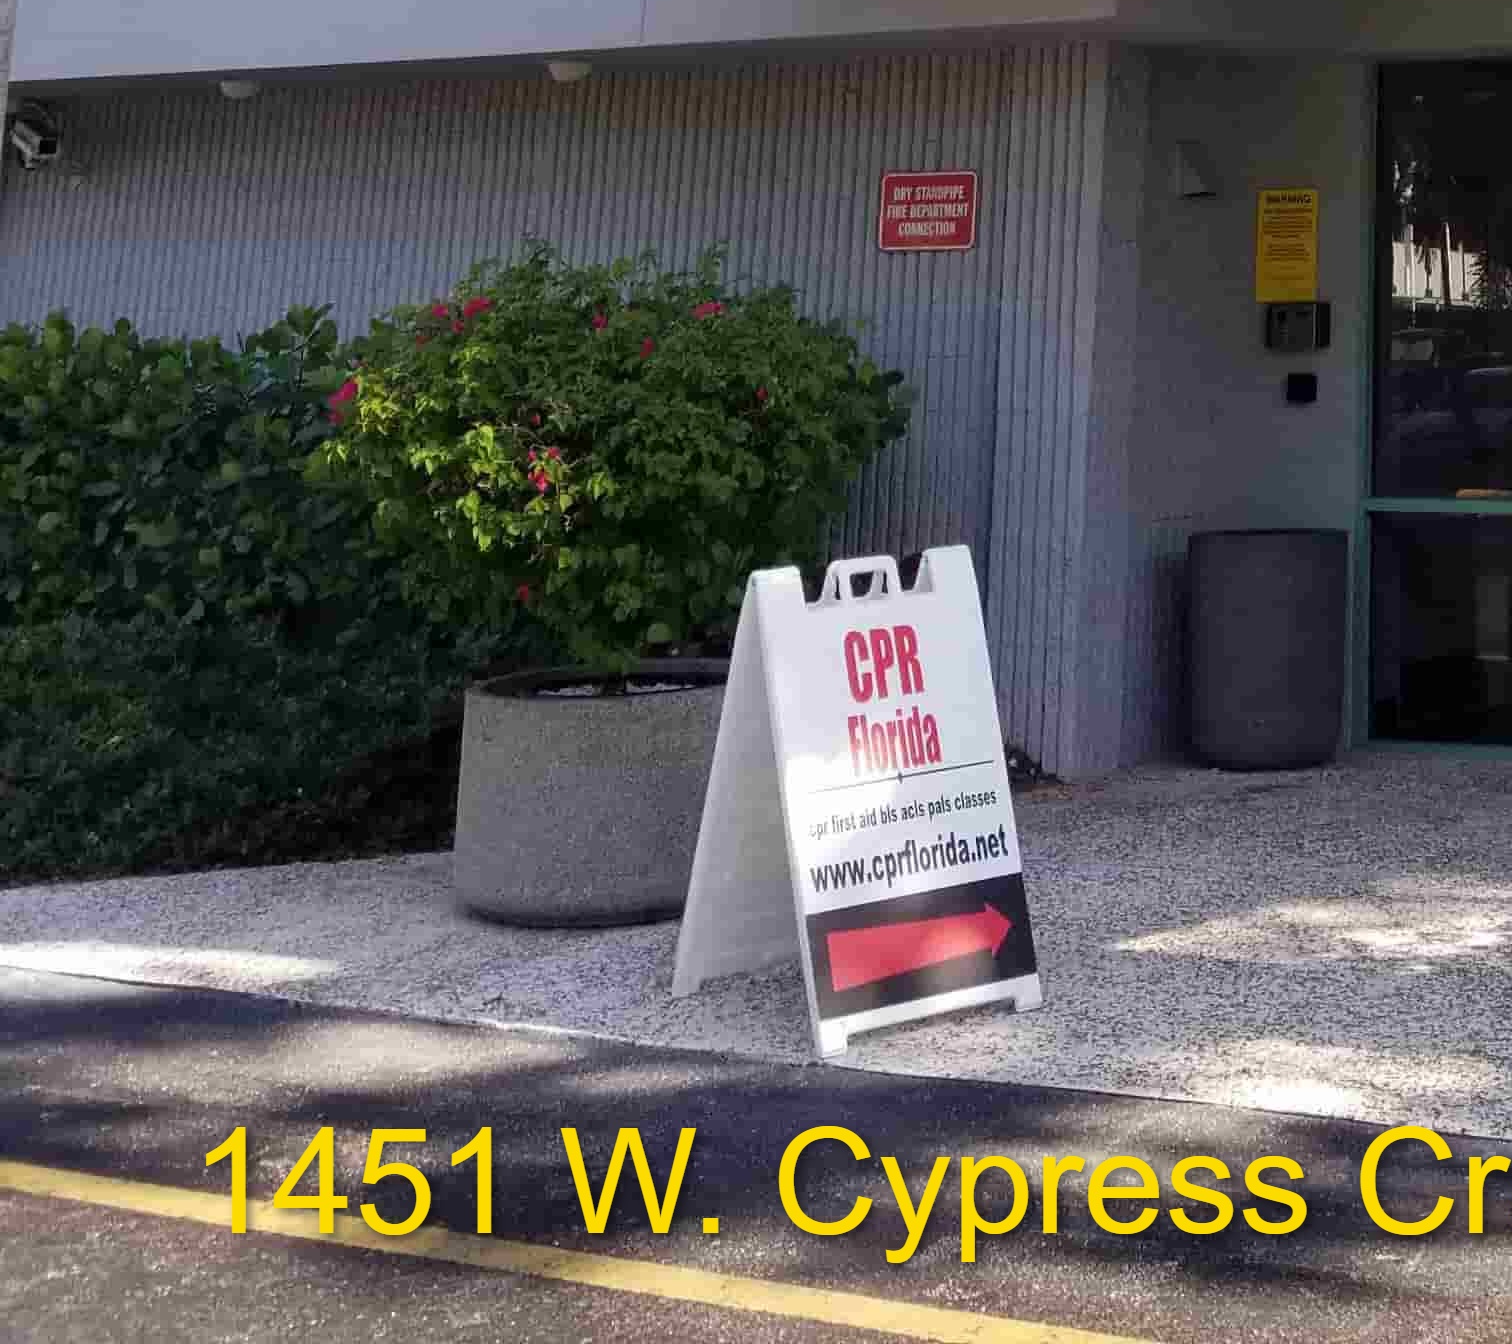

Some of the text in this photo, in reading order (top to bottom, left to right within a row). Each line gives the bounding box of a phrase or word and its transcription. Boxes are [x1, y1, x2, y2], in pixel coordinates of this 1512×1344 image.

[887, 202, 969, 219] FIRE DEPARTMENT
[898, 221, 957, 236] CONNECTION
[844, 625, 925, 703] CPR
[848, 705, 942, 774] Florida
[832, 814, 856, 833] first
[859, 808, 877, 828] aid
[880, 804, 898, 824] bls
[901, 799, 925, 820] acls
[928, 792, 951, 823] pals
[954, 789, 997, 810] classes
[810, 823, 1009, 893] www.cprflorida.net
